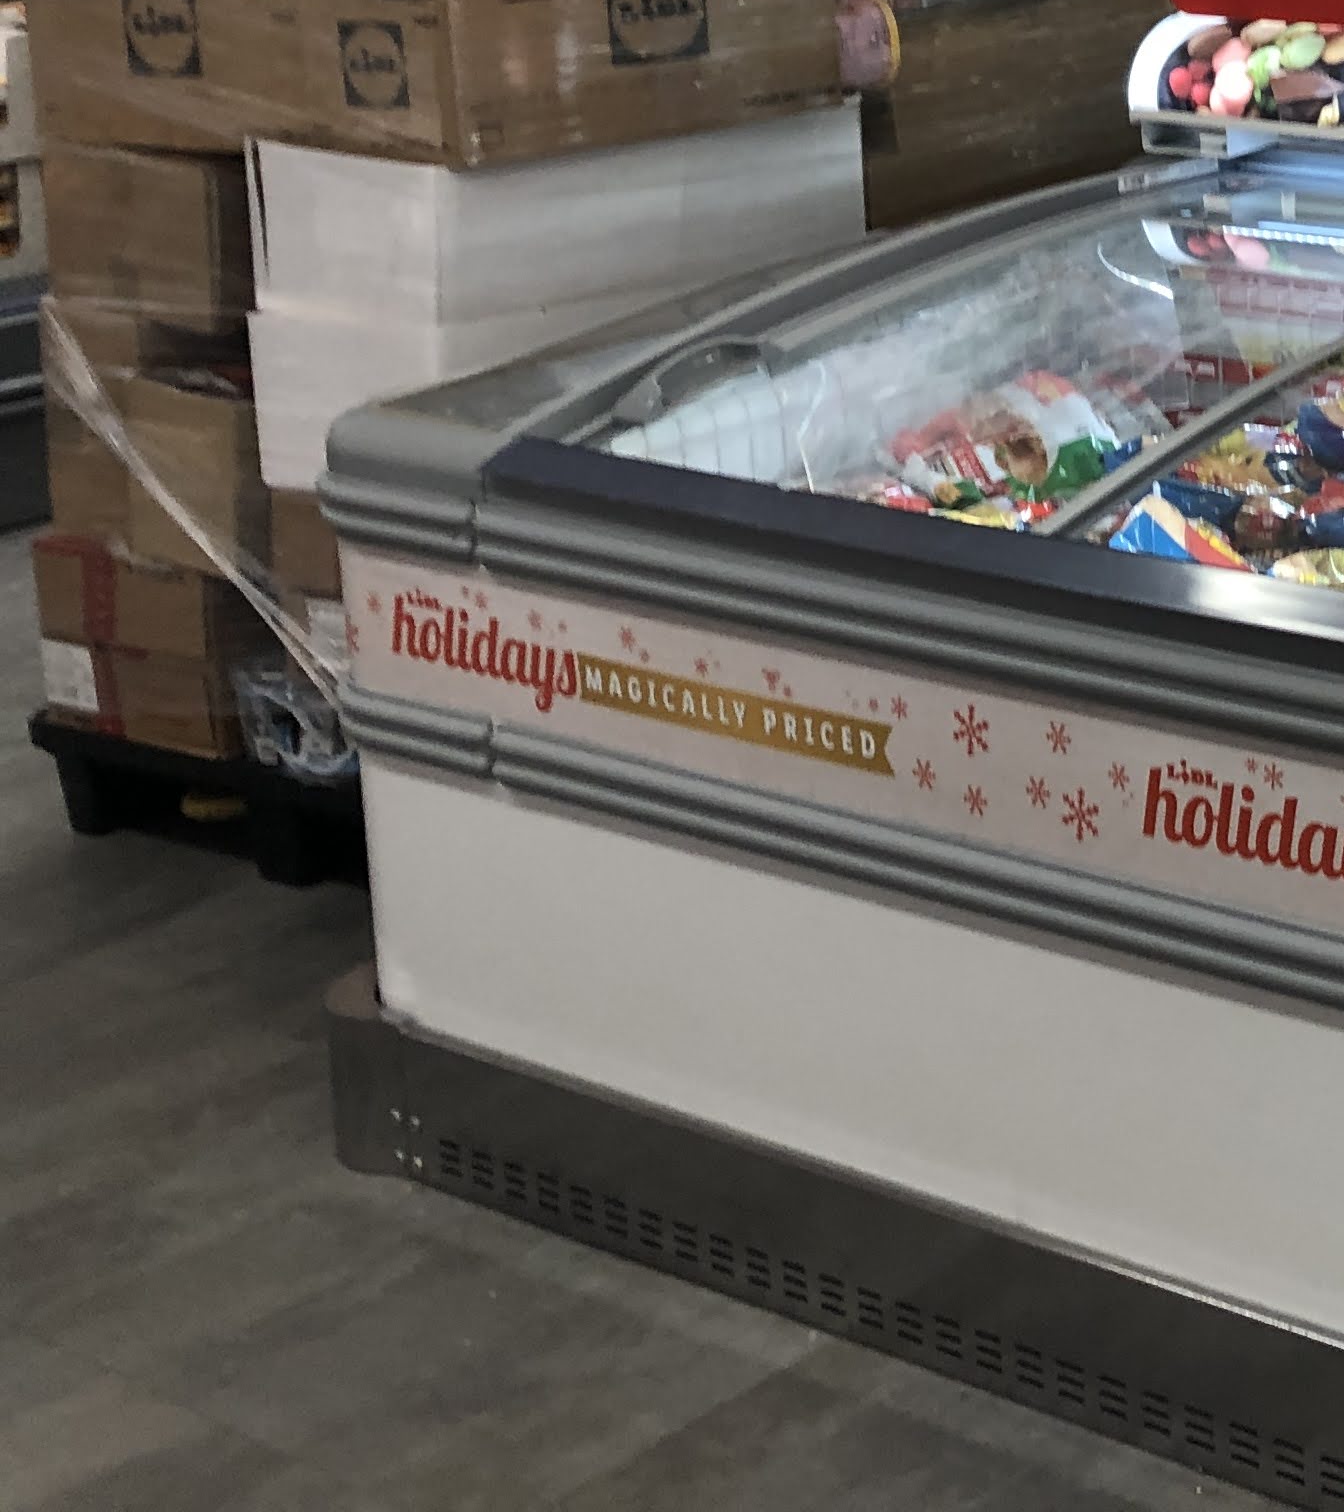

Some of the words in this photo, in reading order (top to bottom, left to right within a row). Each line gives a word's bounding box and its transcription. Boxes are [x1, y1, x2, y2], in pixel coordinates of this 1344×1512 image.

[390, 593, 580, 713] holidays
[584, 661, 748, 730] MAGICALLY
[761, 703, 879, 760] PRICED
